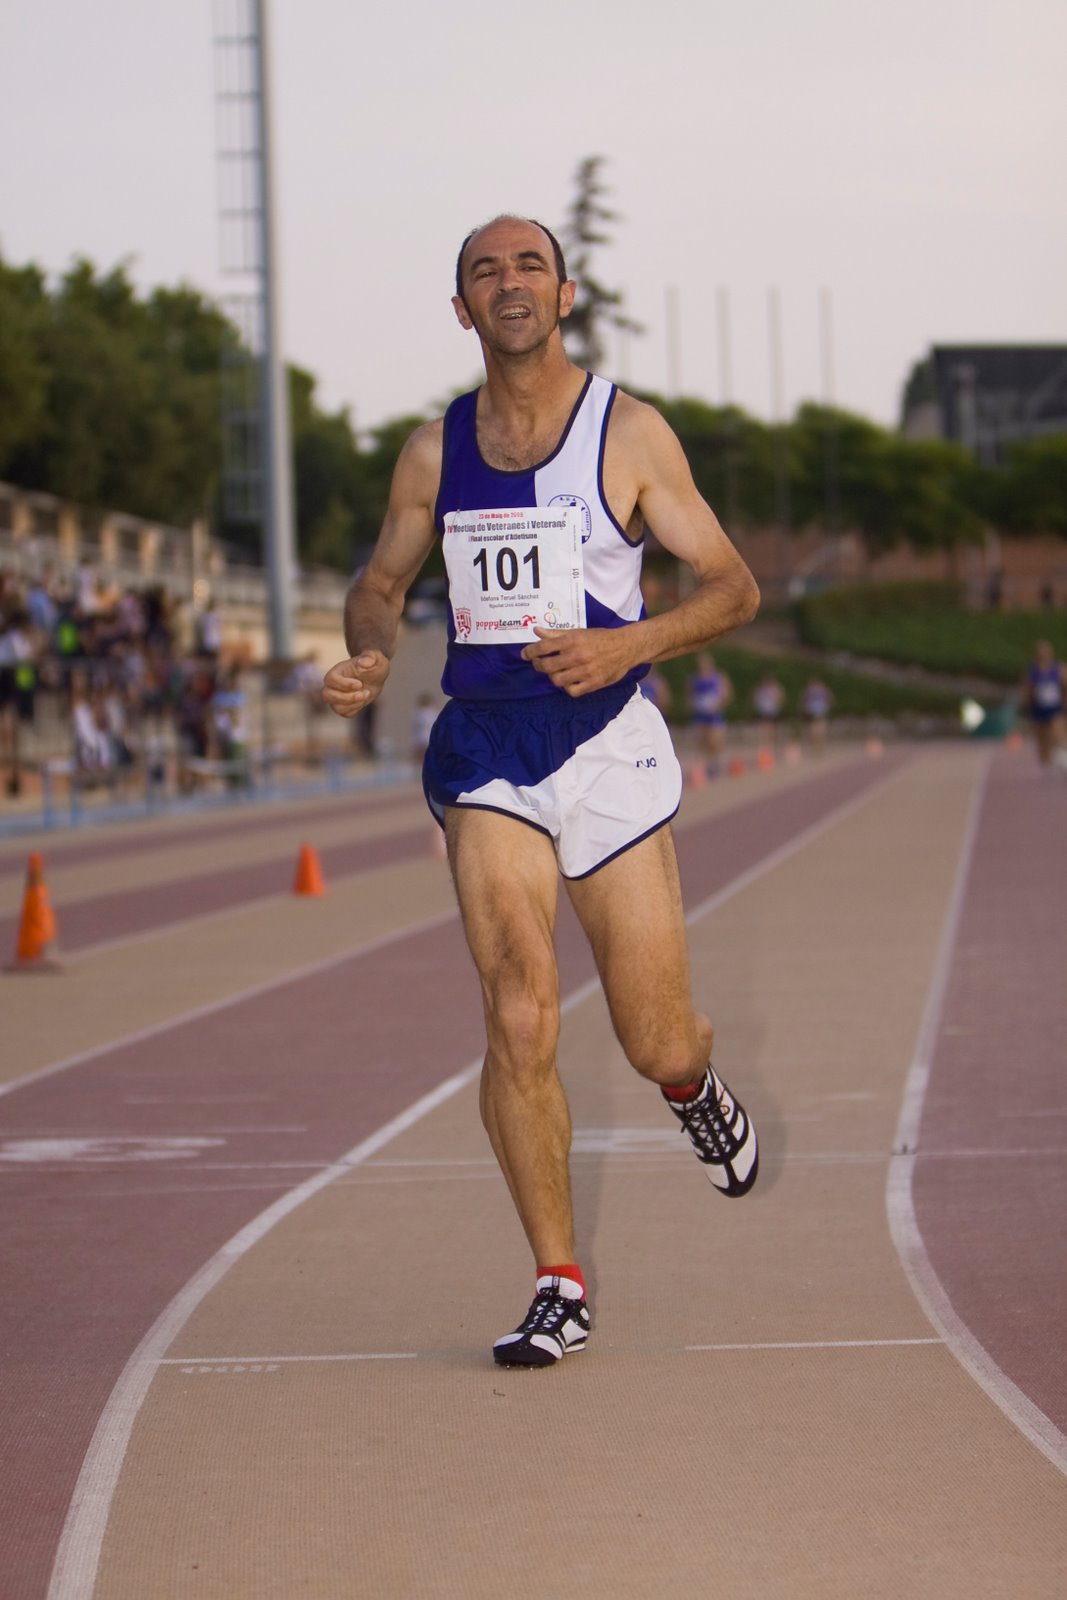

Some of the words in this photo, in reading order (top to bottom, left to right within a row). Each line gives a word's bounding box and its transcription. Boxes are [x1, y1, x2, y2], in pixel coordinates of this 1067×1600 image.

[477, 523, 486, 532] de
[486, 521, 526, 531] Veteranes
[531, 519, 567, 529] Veterans
[473, 545, 541, 591] 101
